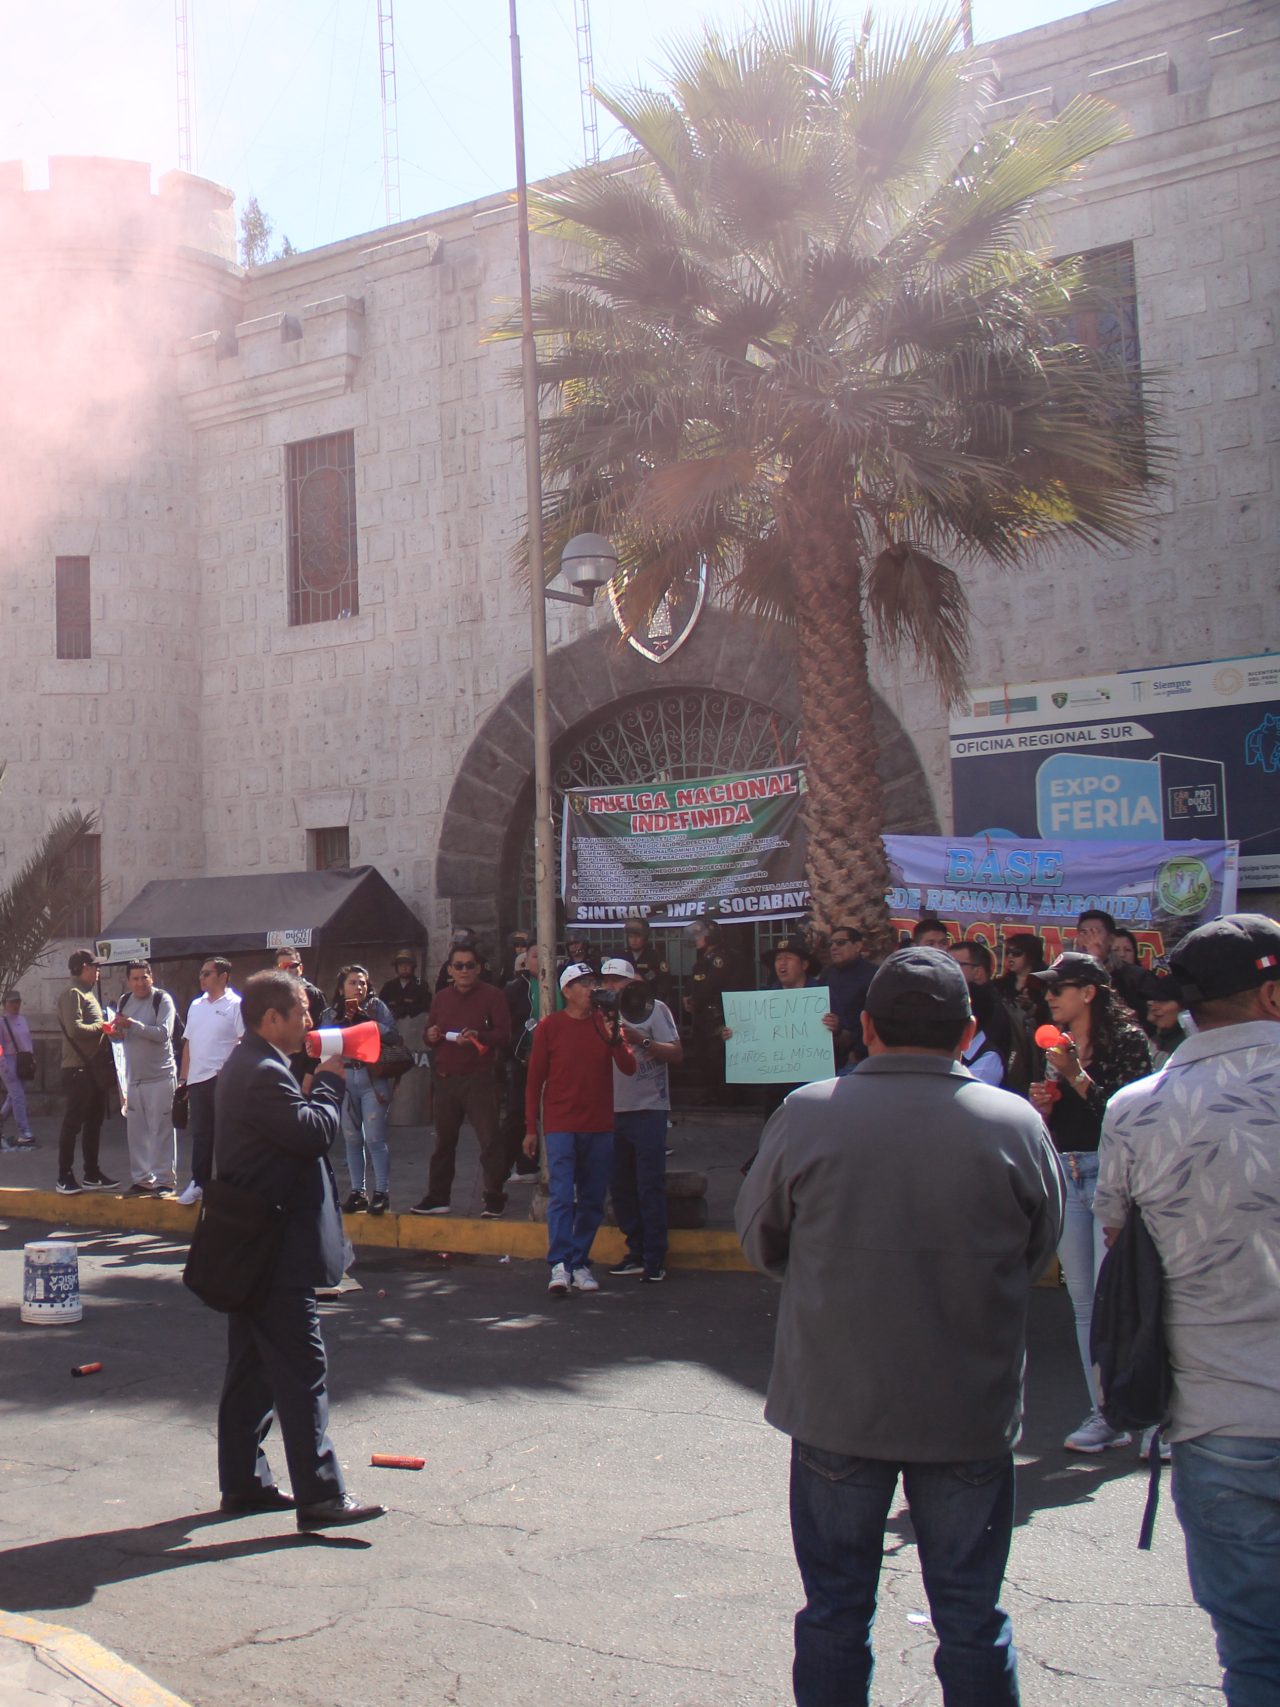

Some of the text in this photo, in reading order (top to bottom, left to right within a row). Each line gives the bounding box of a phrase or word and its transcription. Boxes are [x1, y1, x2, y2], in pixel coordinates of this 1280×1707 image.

[1152, 680, 1192, 690] Siempre
[956, 725, 1133, 755] OFICINA REGIONAL SUR
[676, 773, 797, 807] NACIONAL
[1050, 774, 1121, 798] EXPO
[631, 803, 753, 835] INDEFINIDA
[1051, 796, 1159, 832] FERIA
[944, 848, 1064, 887] BASE
[577, 905, 651, 920] SINTRAP
[666, 901, 706, 918] INPE
[926, 889, 1034, 916] REGIONAL
[1038, 894, 1152, 920] AREQUIPA
[734, 1021, 809, 1045] DEL RIM
[773, 1049, 785, 1061] EL
[791, 1046, 831, 1061] MISMO
[757, 1062, 801, 1076] SUELDO
[51, 1282, 74, 1291] COLA
